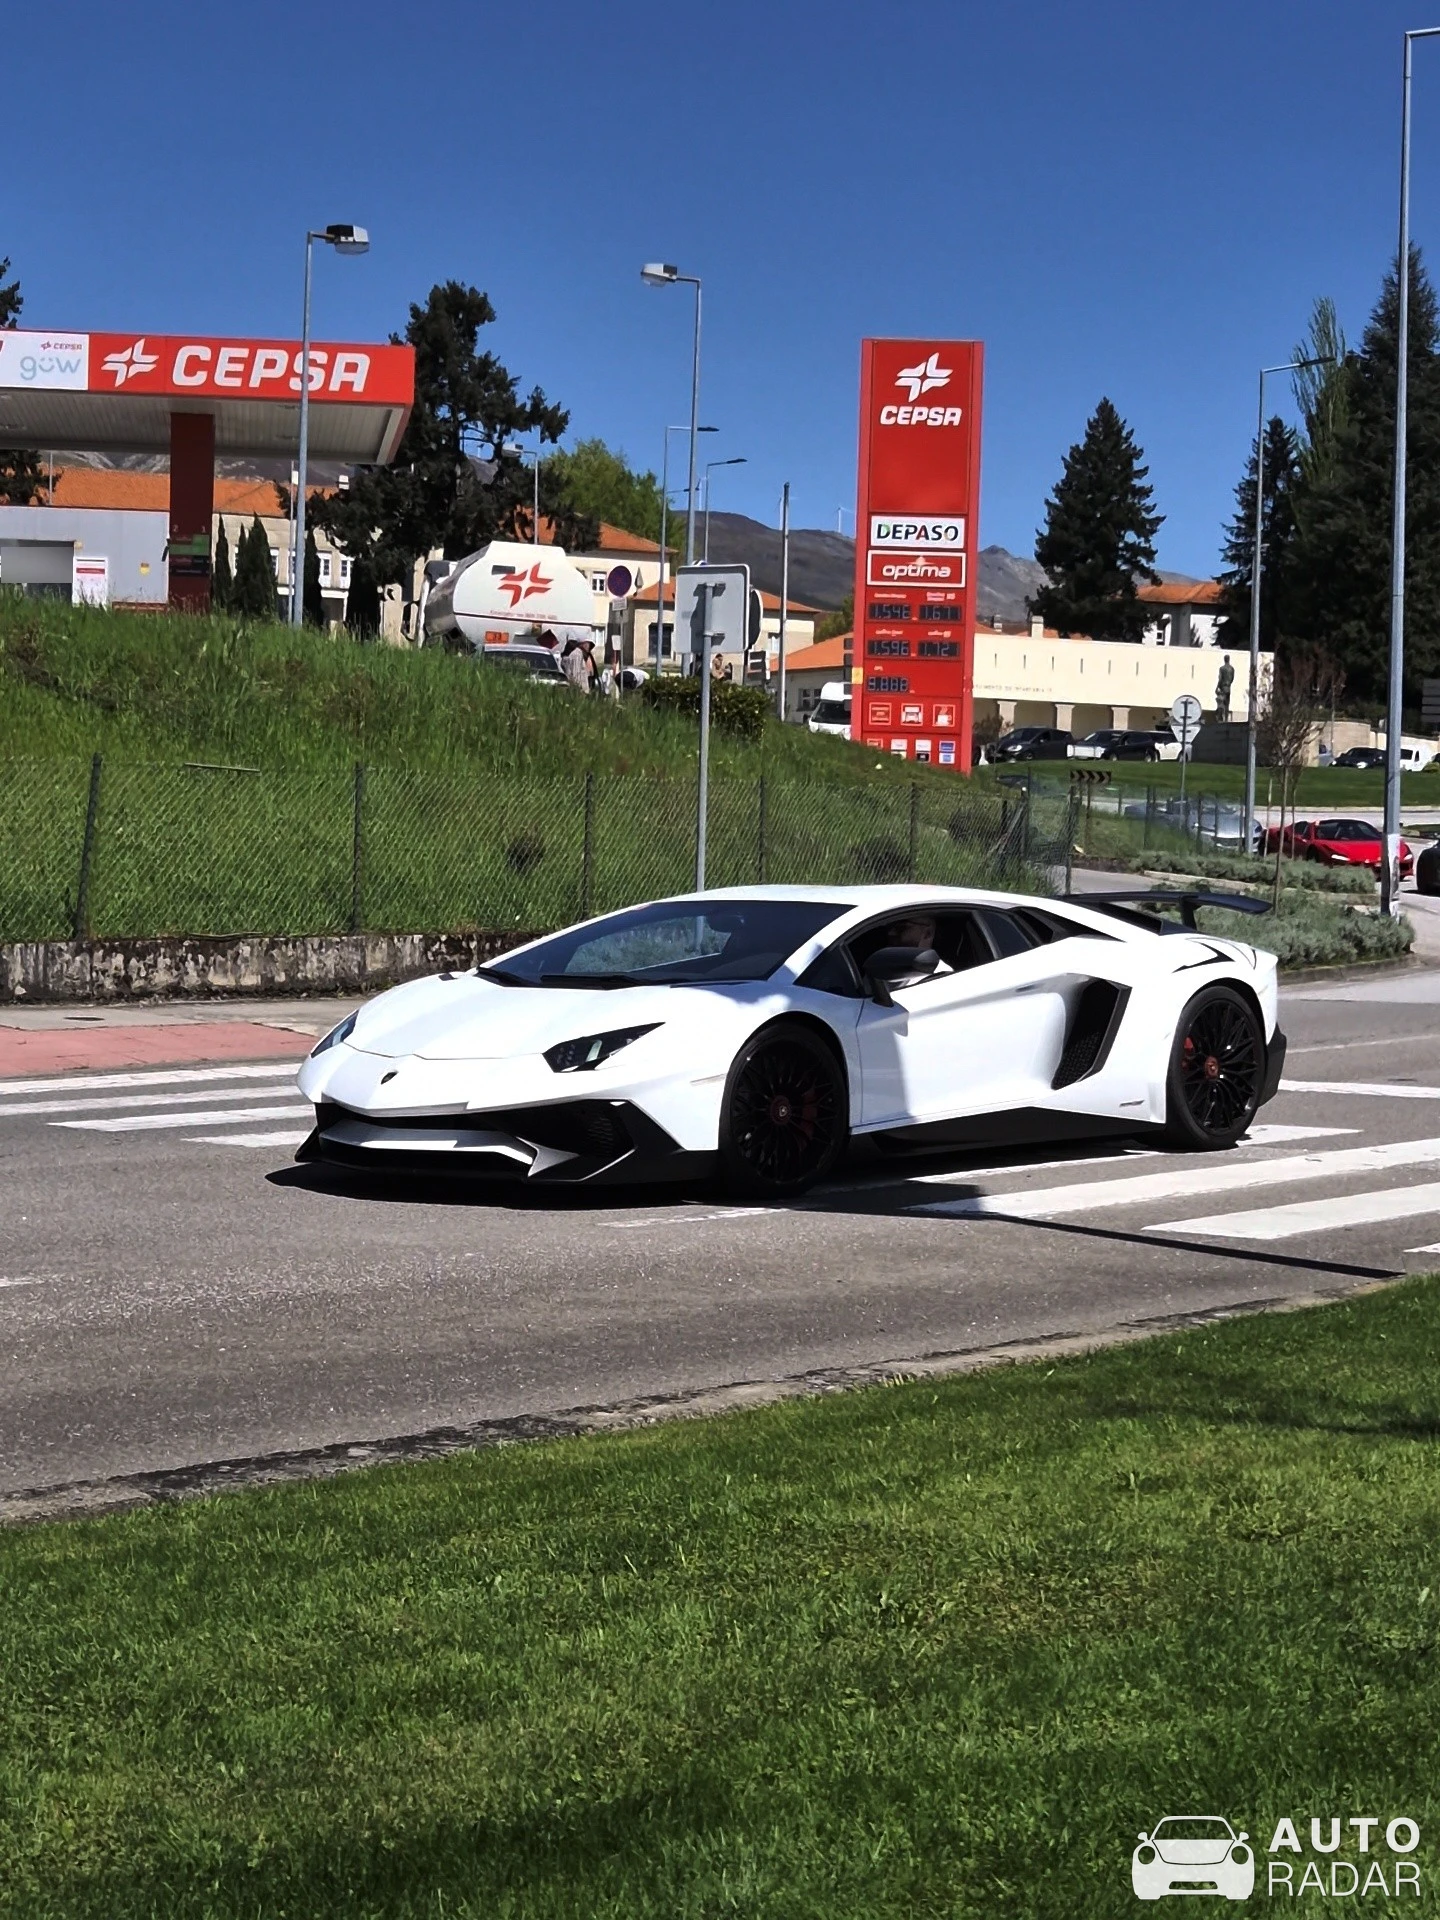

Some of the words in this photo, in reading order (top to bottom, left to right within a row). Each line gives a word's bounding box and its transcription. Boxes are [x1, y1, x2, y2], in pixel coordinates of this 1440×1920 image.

[53, 342, 82, 350] CEPSA
[171, 345, 371, 393] CEPSA
[879, 405, 963, 426] CEPSA
[876, 523, 959, 541] DEPASO
[882, 564, 951, 580] optima
